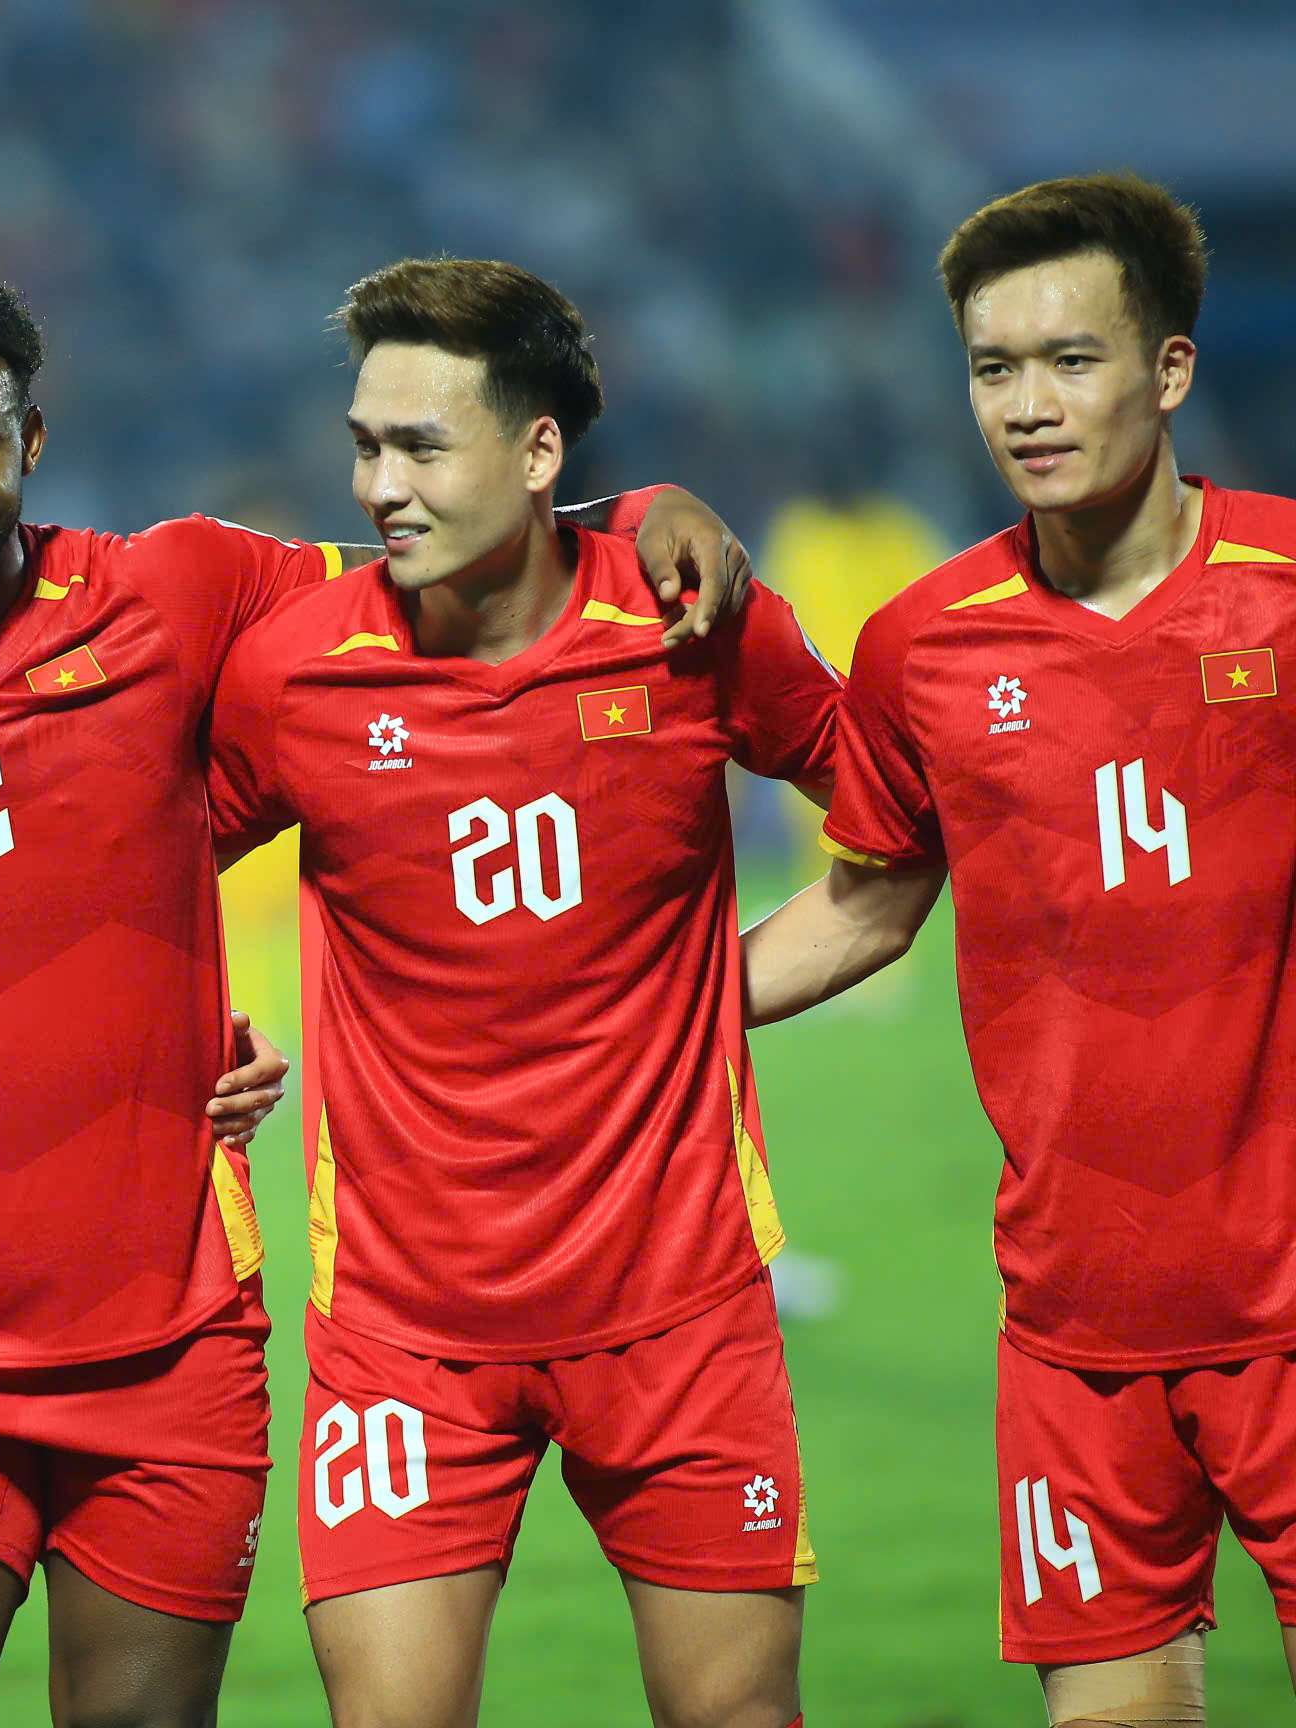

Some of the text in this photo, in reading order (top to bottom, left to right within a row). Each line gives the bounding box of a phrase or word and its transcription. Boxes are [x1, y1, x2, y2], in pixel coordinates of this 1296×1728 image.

[367, 757, 413, 771] JOGARBOLA
[987, 718, 1031, 735] JOGARBOLA
[447, 791, 583, 926] 20
[1094, 757, 1192, 893] 14
[314, 1397, 430, 1530] 20
[741, 1517, 783, 1532] JOGARBOLA
[1015, 1475, 1103, 1607] 14
